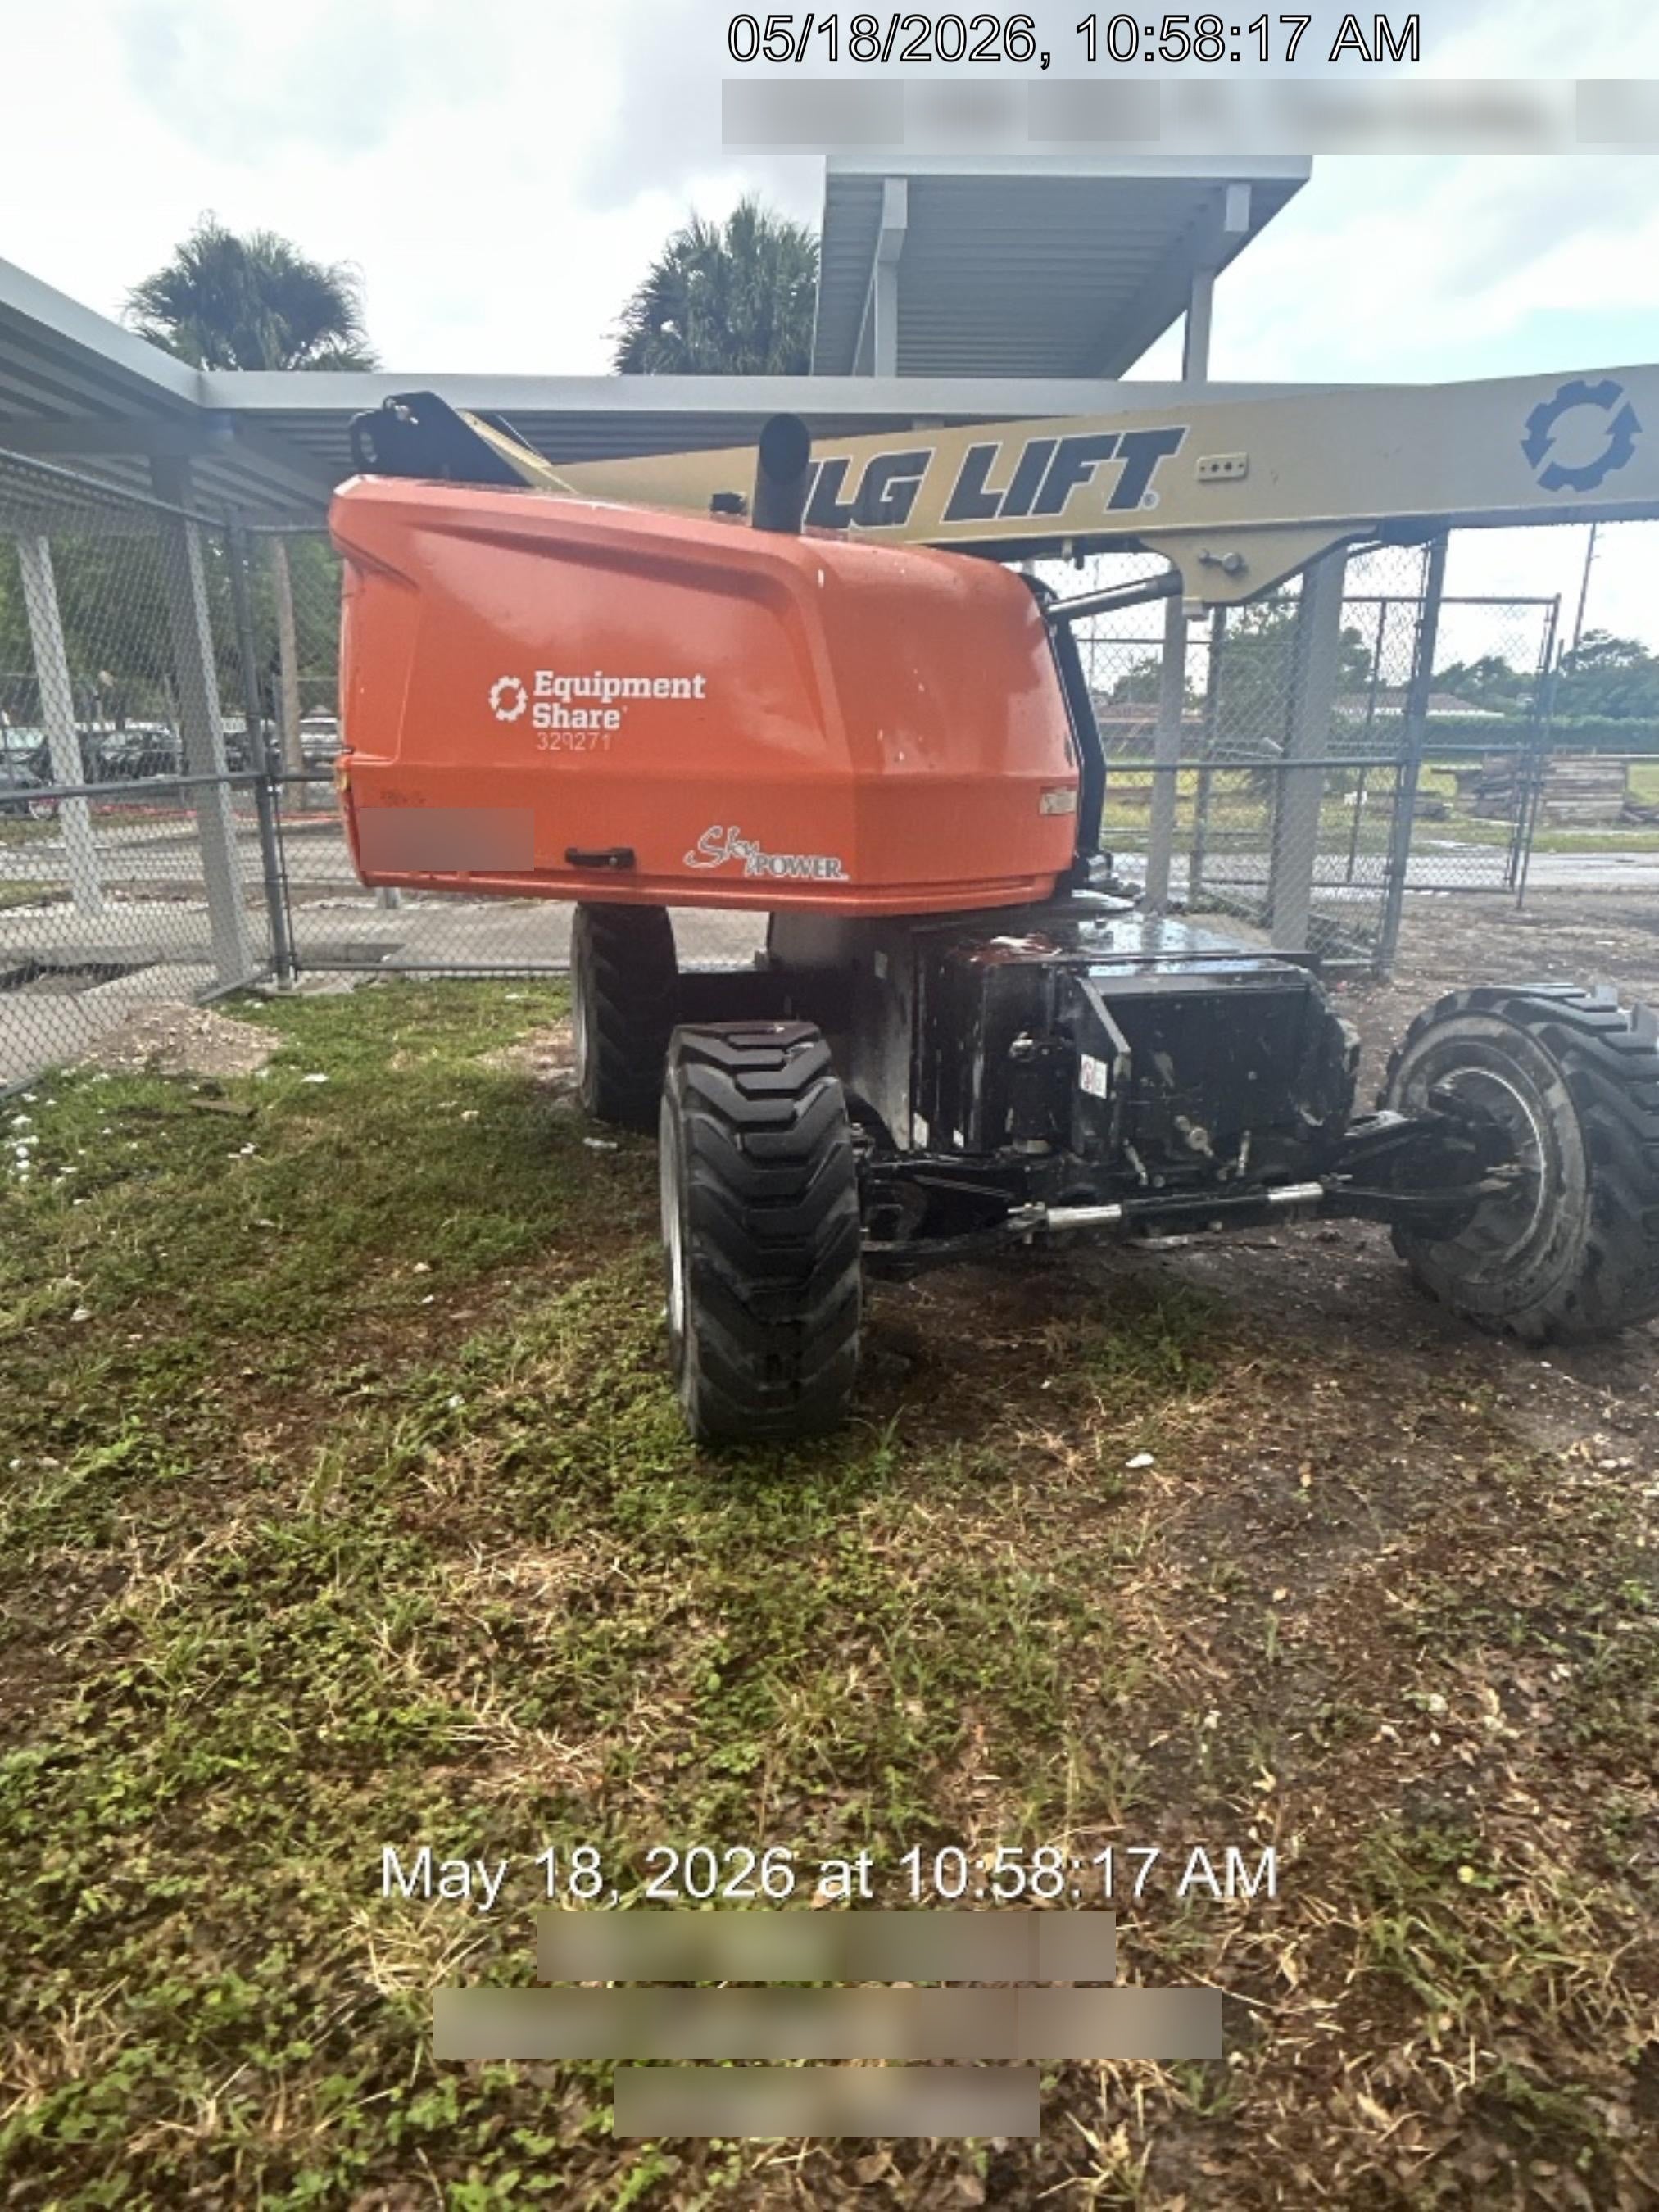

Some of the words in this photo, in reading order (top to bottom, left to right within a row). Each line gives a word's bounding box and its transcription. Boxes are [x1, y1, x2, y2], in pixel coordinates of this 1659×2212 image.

[800, 447, 936, 531] LG
[940, 424, 1190, 524] LIFT
[533, 669, 707, 704] Equipment
[533, 702, 621, 730] Share
[537, 731, 611, 751] 329271
